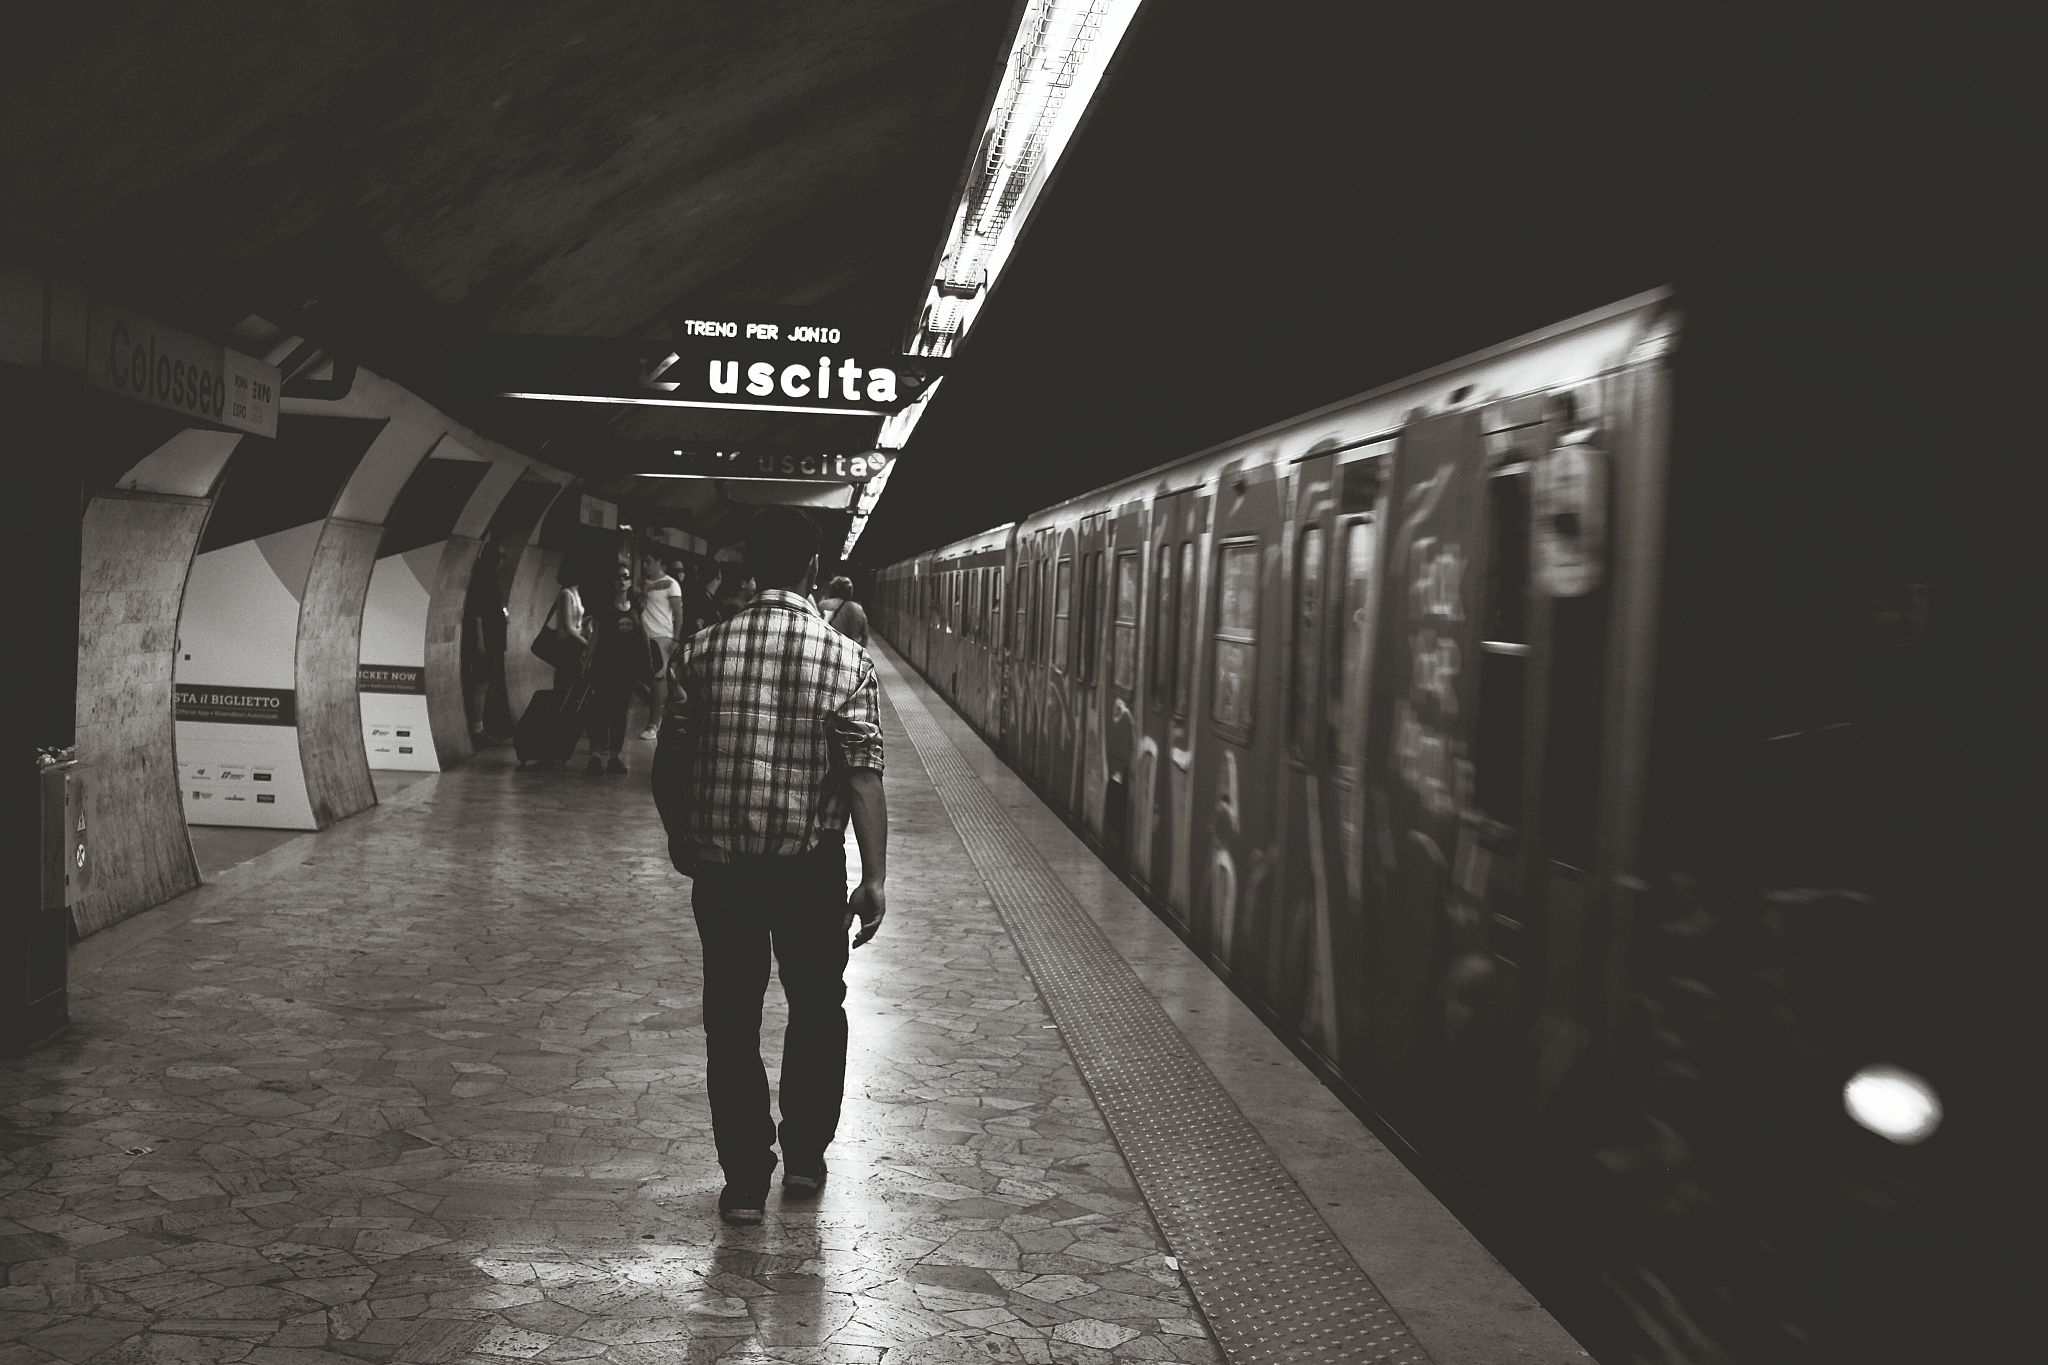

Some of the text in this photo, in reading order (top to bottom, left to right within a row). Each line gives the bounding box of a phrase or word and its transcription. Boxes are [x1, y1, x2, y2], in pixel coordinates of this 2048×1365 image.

[684, 320, 841, 344] TRENO PER JONIO
[110, 320, 226, 418] Colosseo
[708, 356, 898, 402] uscita
[232, 402, 247, 420] EXPO
[758, 453, 867, 477] uscita
[391, 672, 417, 682] NOW
[174, 692, 280, 709] STA il BIGLIETTO
